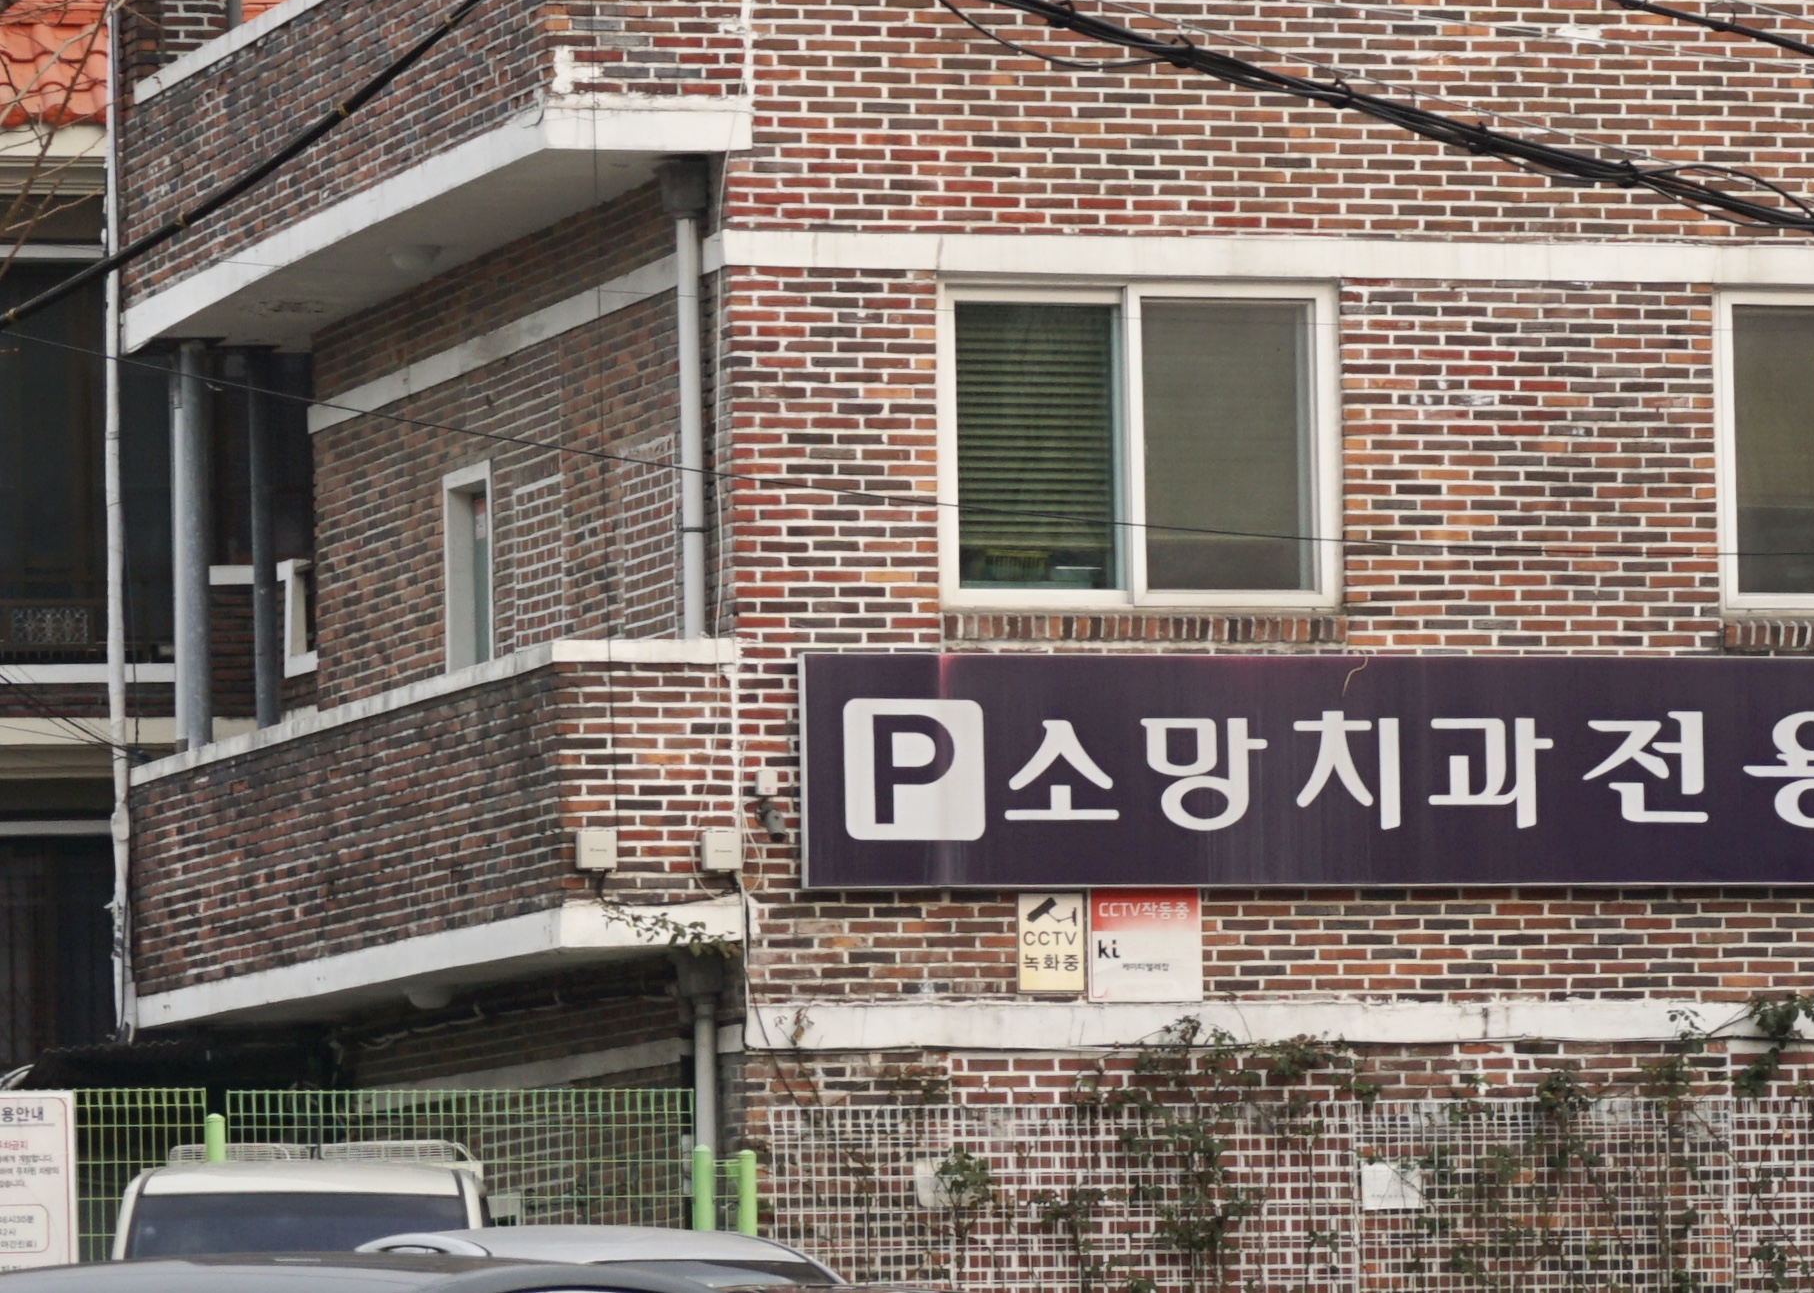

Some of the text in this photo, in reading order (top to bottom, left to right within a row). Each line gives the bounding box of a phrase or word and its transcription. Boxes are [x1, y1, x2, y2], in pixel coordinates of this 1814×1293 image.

[1097, 901, 1190, 920] CCTV작동중
[1022, 930, 1078, 946] CCTV
[1022, 953, 1080, 972] 녹화중
